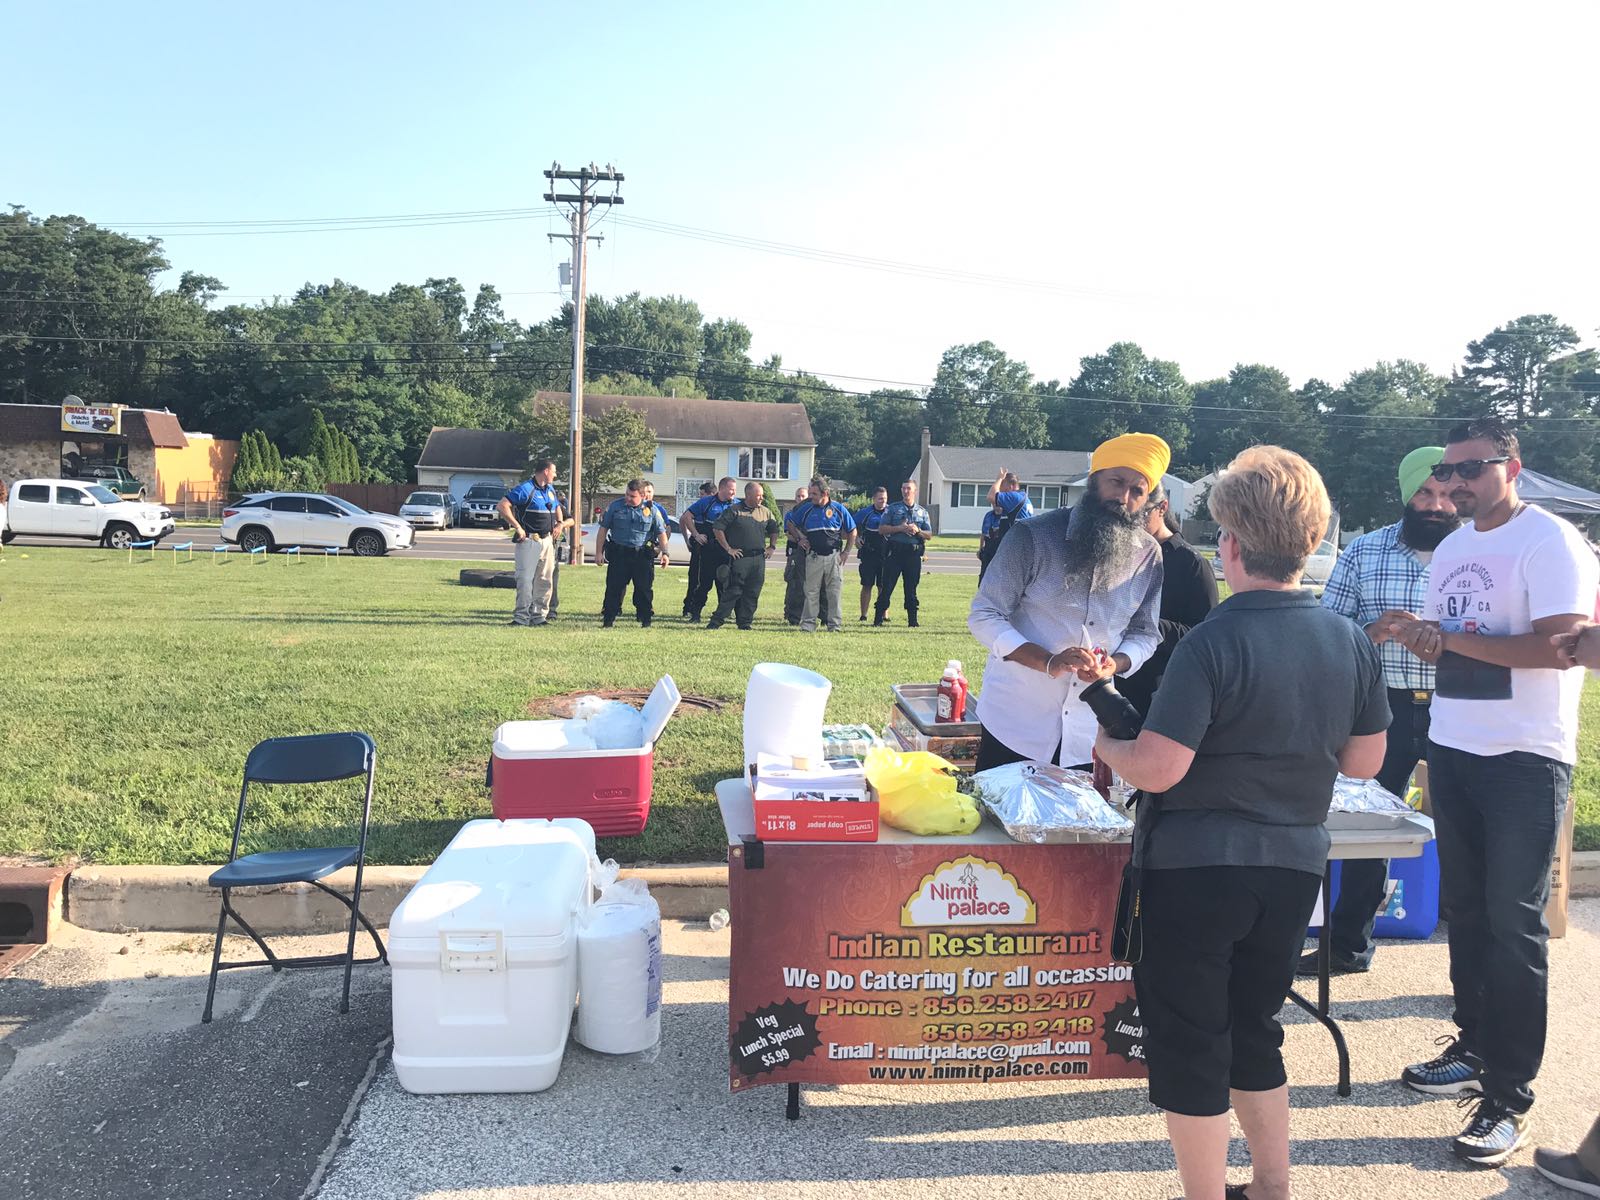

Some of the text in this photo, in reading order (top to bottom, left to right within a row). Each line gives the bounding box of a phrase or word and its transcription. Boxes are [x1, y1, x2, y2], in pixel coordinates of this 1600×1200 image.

[1456, 580, 1471, 588] USA
[1478, 601, 1491, 612] CA
[807, 821, 827, 829] paper
[827, 821, 844, 829] copy
[930, 883, 979, 900] Nimit
[947, 899, 1010, 919] palace
[829, 931, 1101, 958] Indian Restaurant
[783, 967, 820, 988] We
[826, 969, 854, 990] Do
[860, 969, 957, 995] Catering
[962, 967, 998, 988] for
[1003, 965, 1030, 987] all
[819, 998, 902, 1016] Phone
[923, 991, 1095, 1016] 856.258.2417
[755, 1014, 779, 1029] Veg
[922, 1017, 1094, 1042] 856.258.2418
[1114, 1019, 1143, 1038] Lunch
[739, 1023, 805, 1057] Lunch Special
[761, 1048, 790, 1067] $5.99
[828, 1042, 874, 1059] Email
[888, 1038, 1091, 1064] nimitpalace@gmail.com
[869, 1061, 1089, 1082] www.nimitpalace.com
